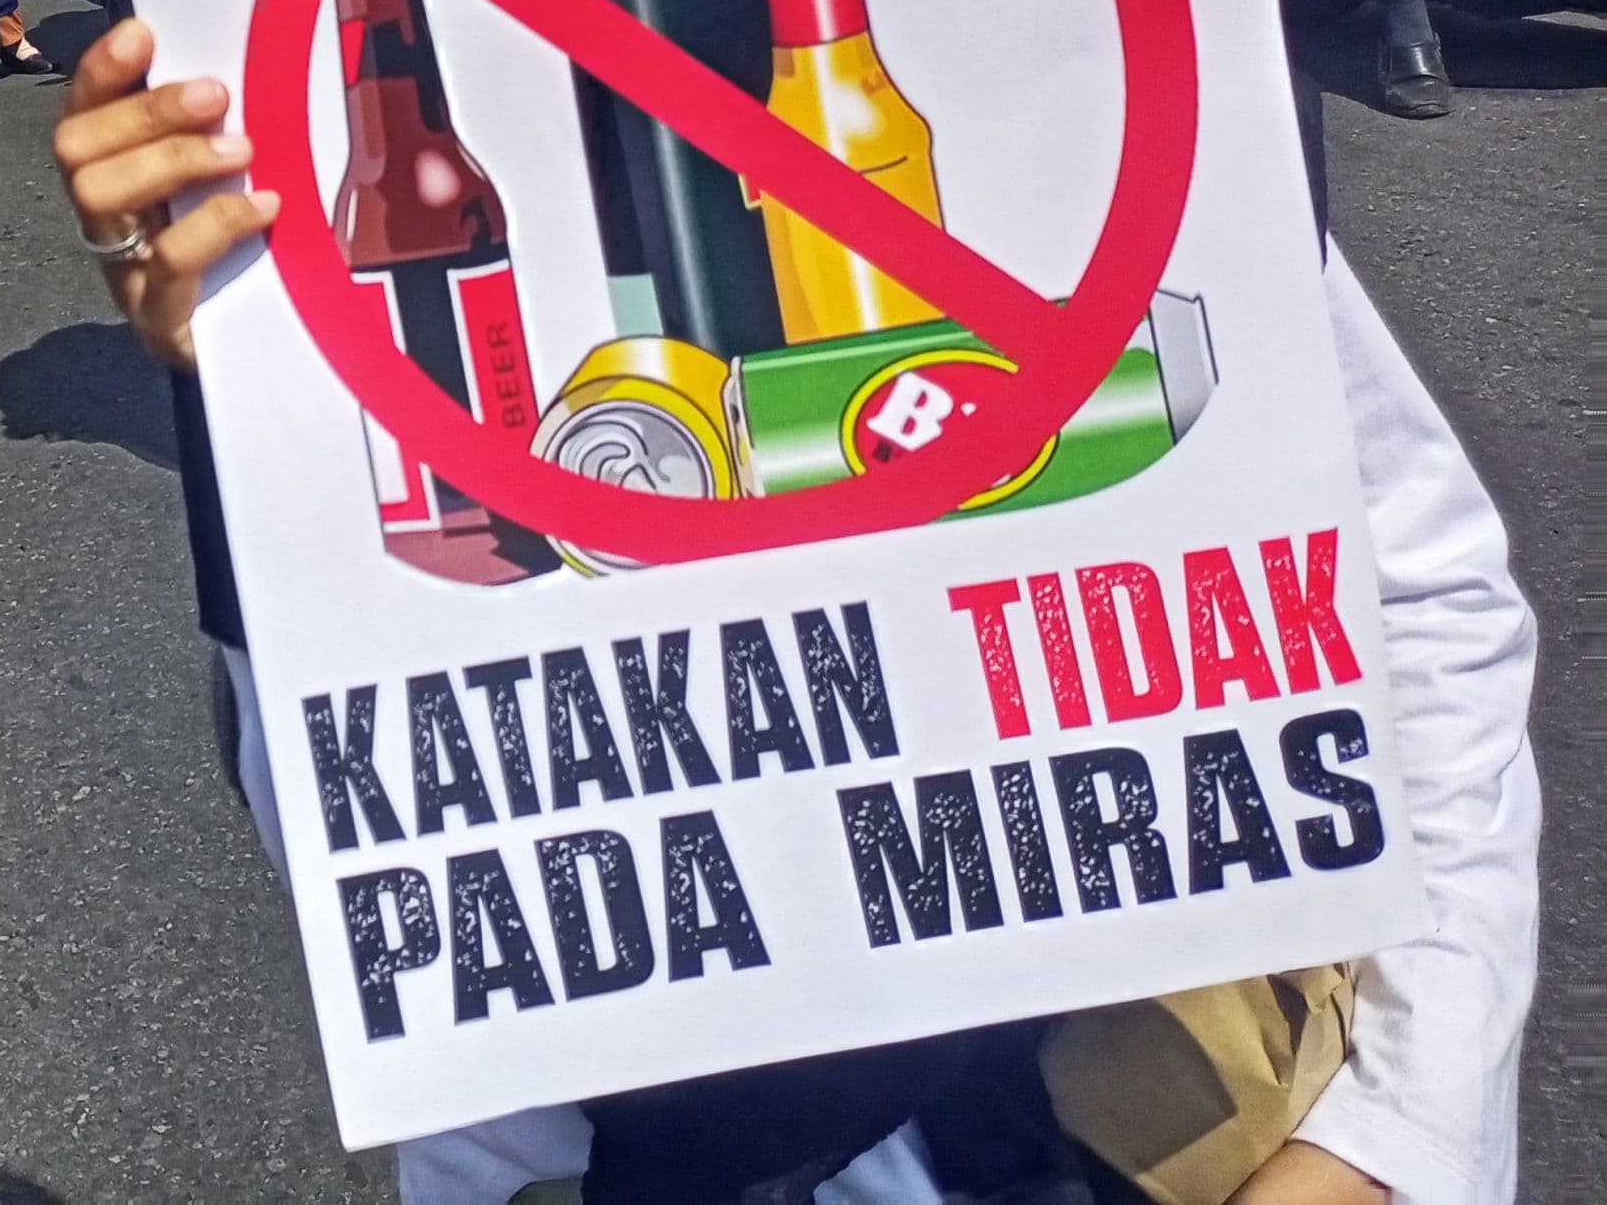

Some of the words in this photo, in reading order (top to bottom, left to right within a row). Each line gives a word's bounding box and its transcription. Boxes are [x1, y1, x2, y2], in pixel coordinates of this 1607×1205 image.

[487, 322, 526, 429] BEER
[301, 601, 900, 854] KATAKAN
[948, 527, 1362, 741] TIDAK
[336, 809, 773, 1044] PADA
[835, 707, 1386, 950] MIRAS
